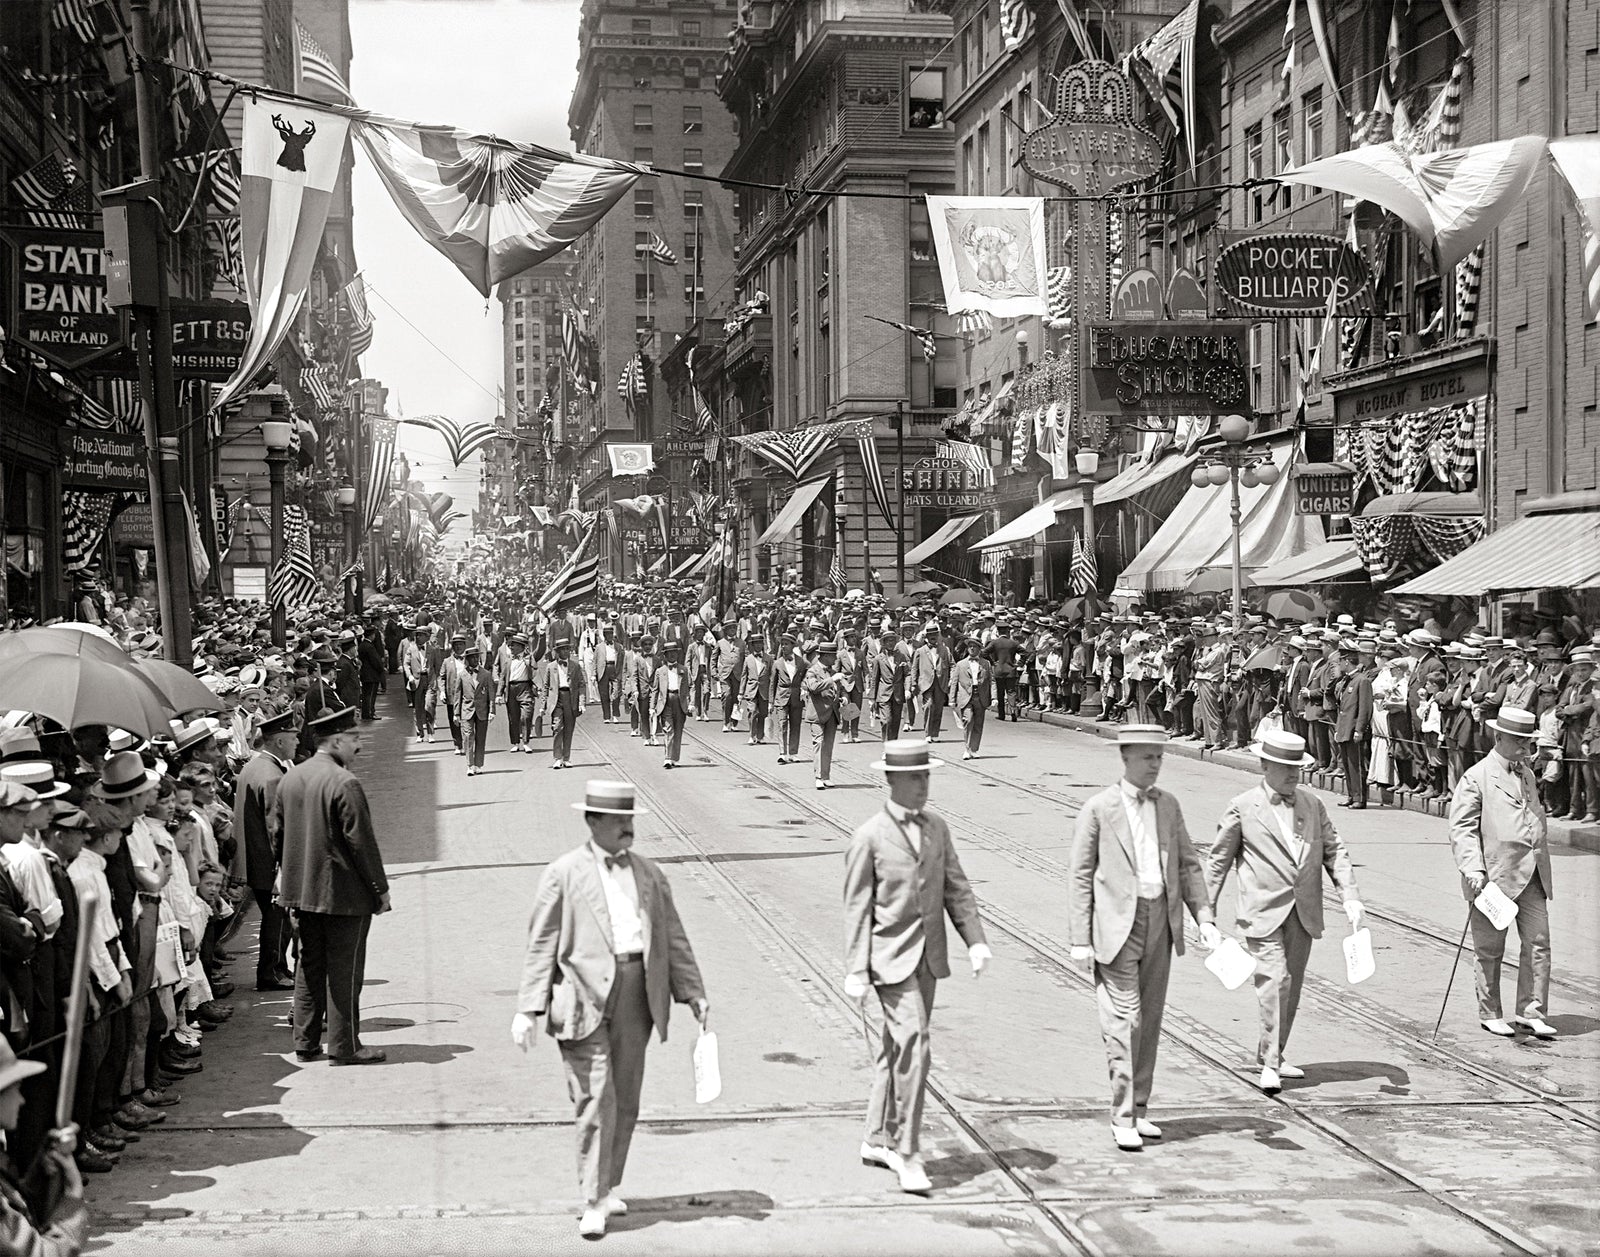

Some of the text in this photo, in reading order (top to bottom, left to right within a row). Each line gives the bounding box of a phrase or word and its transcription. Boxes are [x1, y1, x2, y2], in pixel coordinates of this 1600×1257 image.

[1030, 130, 1153, 162] OLYMPIA
[1249, 247, 1338, 269] POCKET
[1238, 275, 1349, 298] BILLIARDS
[59, 315, 80, 329] OF
[29, 329, 109, 345] MARYLAND
[1089, 326, 1244, 369] EDUCATOR
[1115, 361, 1205, 405] SHOE
[1420, 376, 1466, 402] HOTEL
[72, 434, 135, 457] The National
[104, 459, 133, 480] Goods
[133, 463, 147, 480] Co.
[922, 459, 960, 469] SHOE
[903, 471, 979, 490] SHINE
[1299, 477, 1349, 493] UNITED
[905, 494, 979, 506] HATS CLEANED
[1299, 496, 1351, 513] CIGARS
[117, 514, 154, 523] TELEPHON
[122, 523, 154, 532] BOOTHS
[214, 496, 227, 545] SODA
[651, 527, 680, 537] BAER
[682, 527, 700, 537] SHOP
[674, 536, 700, 546] SHINES
